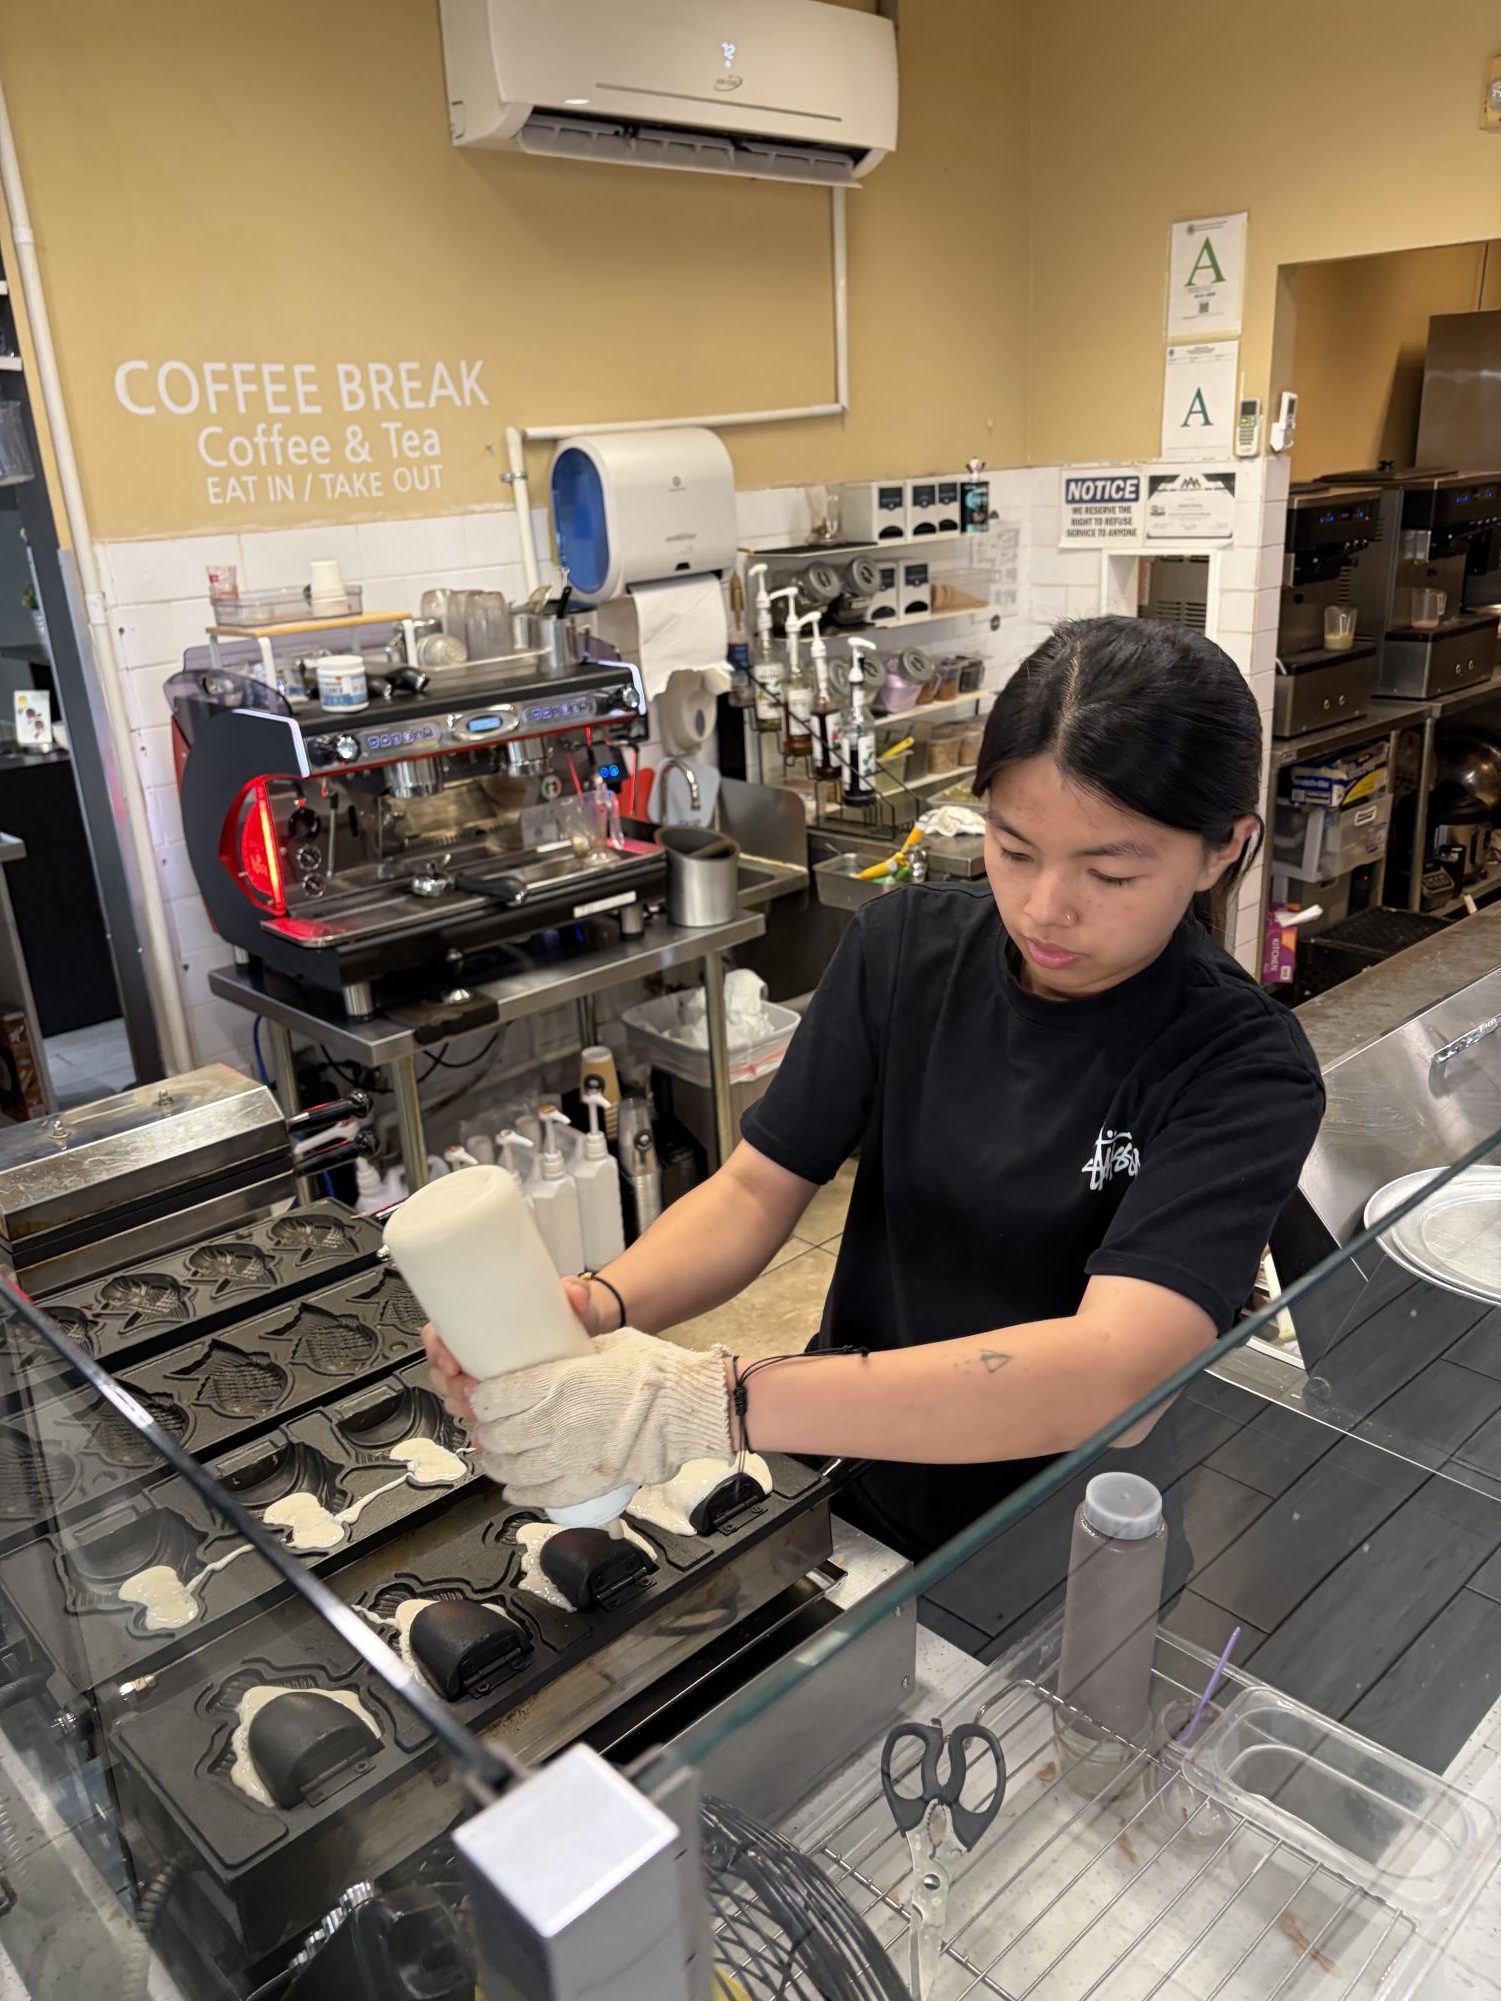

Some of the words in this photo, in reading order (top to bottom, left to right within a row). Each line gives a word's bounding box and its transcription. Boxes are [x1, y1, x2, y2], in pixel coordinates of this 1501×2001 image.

[1184, 236, 1227, 287] A
[114, 360, 323, 416] COFFEE
[336, 360, 490, 412] BREAK
[1180, 386, 1214, 428] A
[198, 423, 331, 468] Coffee
[345, 424, 372, 464] &
[380, 421, 441, 460] Tea
[206, 475, 259, 505] EAT
[267, 473, 295, 502] IN
[303, 473, 313, 502] /
[320, 471, 384, 500] TAKE
[393, 464, 443, 494] OUT
[1067, 479, 1138, 501] NOTICE
[1071, 517, 1093, 526] RIGHT
[1094, 517, 1103, 526] TO
[1104, 516, 1132, 526] REFUSE
[1072, 506, 1083, 515] WE
[1085, 505, 1116, 515] RESERVE
[1118, 505, 1132, 514] THE
[1066, 528, 1096, 537] SERVICE
[1098, 528, 1106, 537] TO
[1108, 527, 1137, 537] ANYONE
